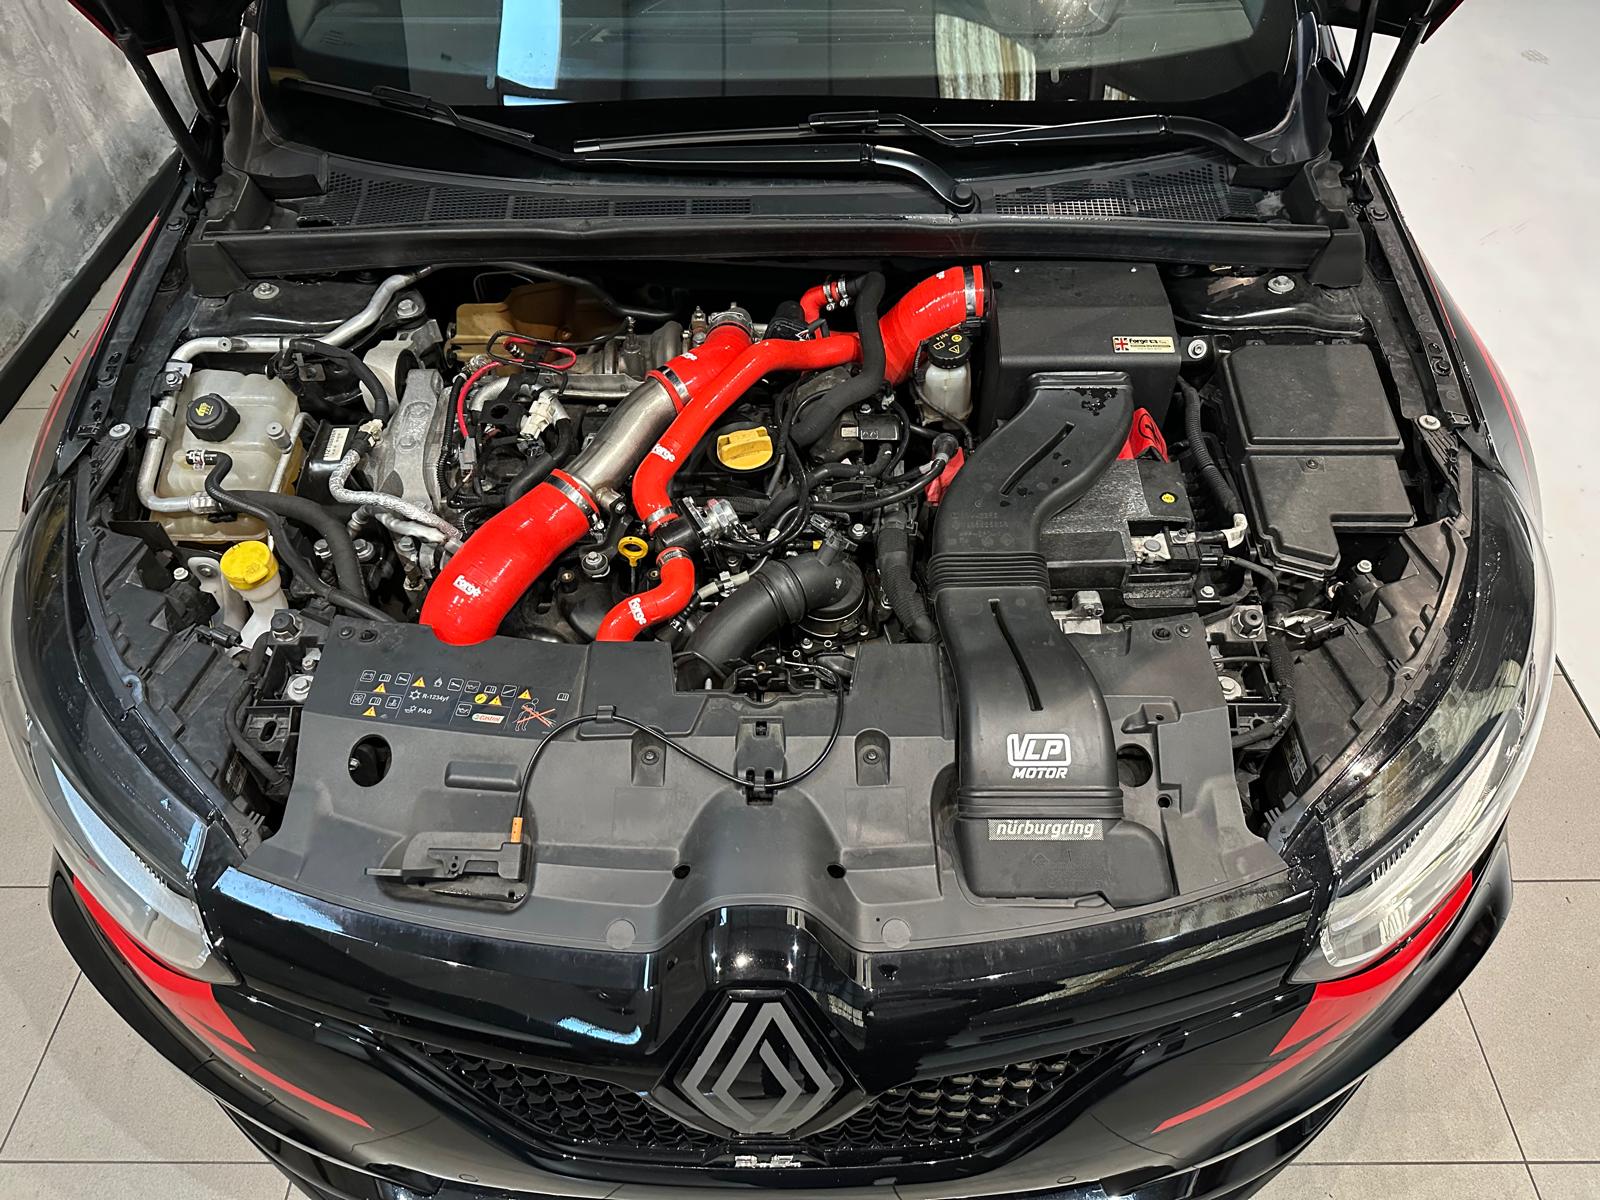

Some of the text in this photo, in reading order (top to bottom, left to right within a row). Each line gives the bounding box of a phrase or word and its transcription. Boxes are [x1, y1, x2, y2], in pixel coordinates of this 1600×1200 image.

[417, 707, 433, 715] PAG
[1007, 734, 1070, 765] VLP
[1012, 767, 1068, 779] MOTOR
[996, 819, 1096, 839] nürburgring
